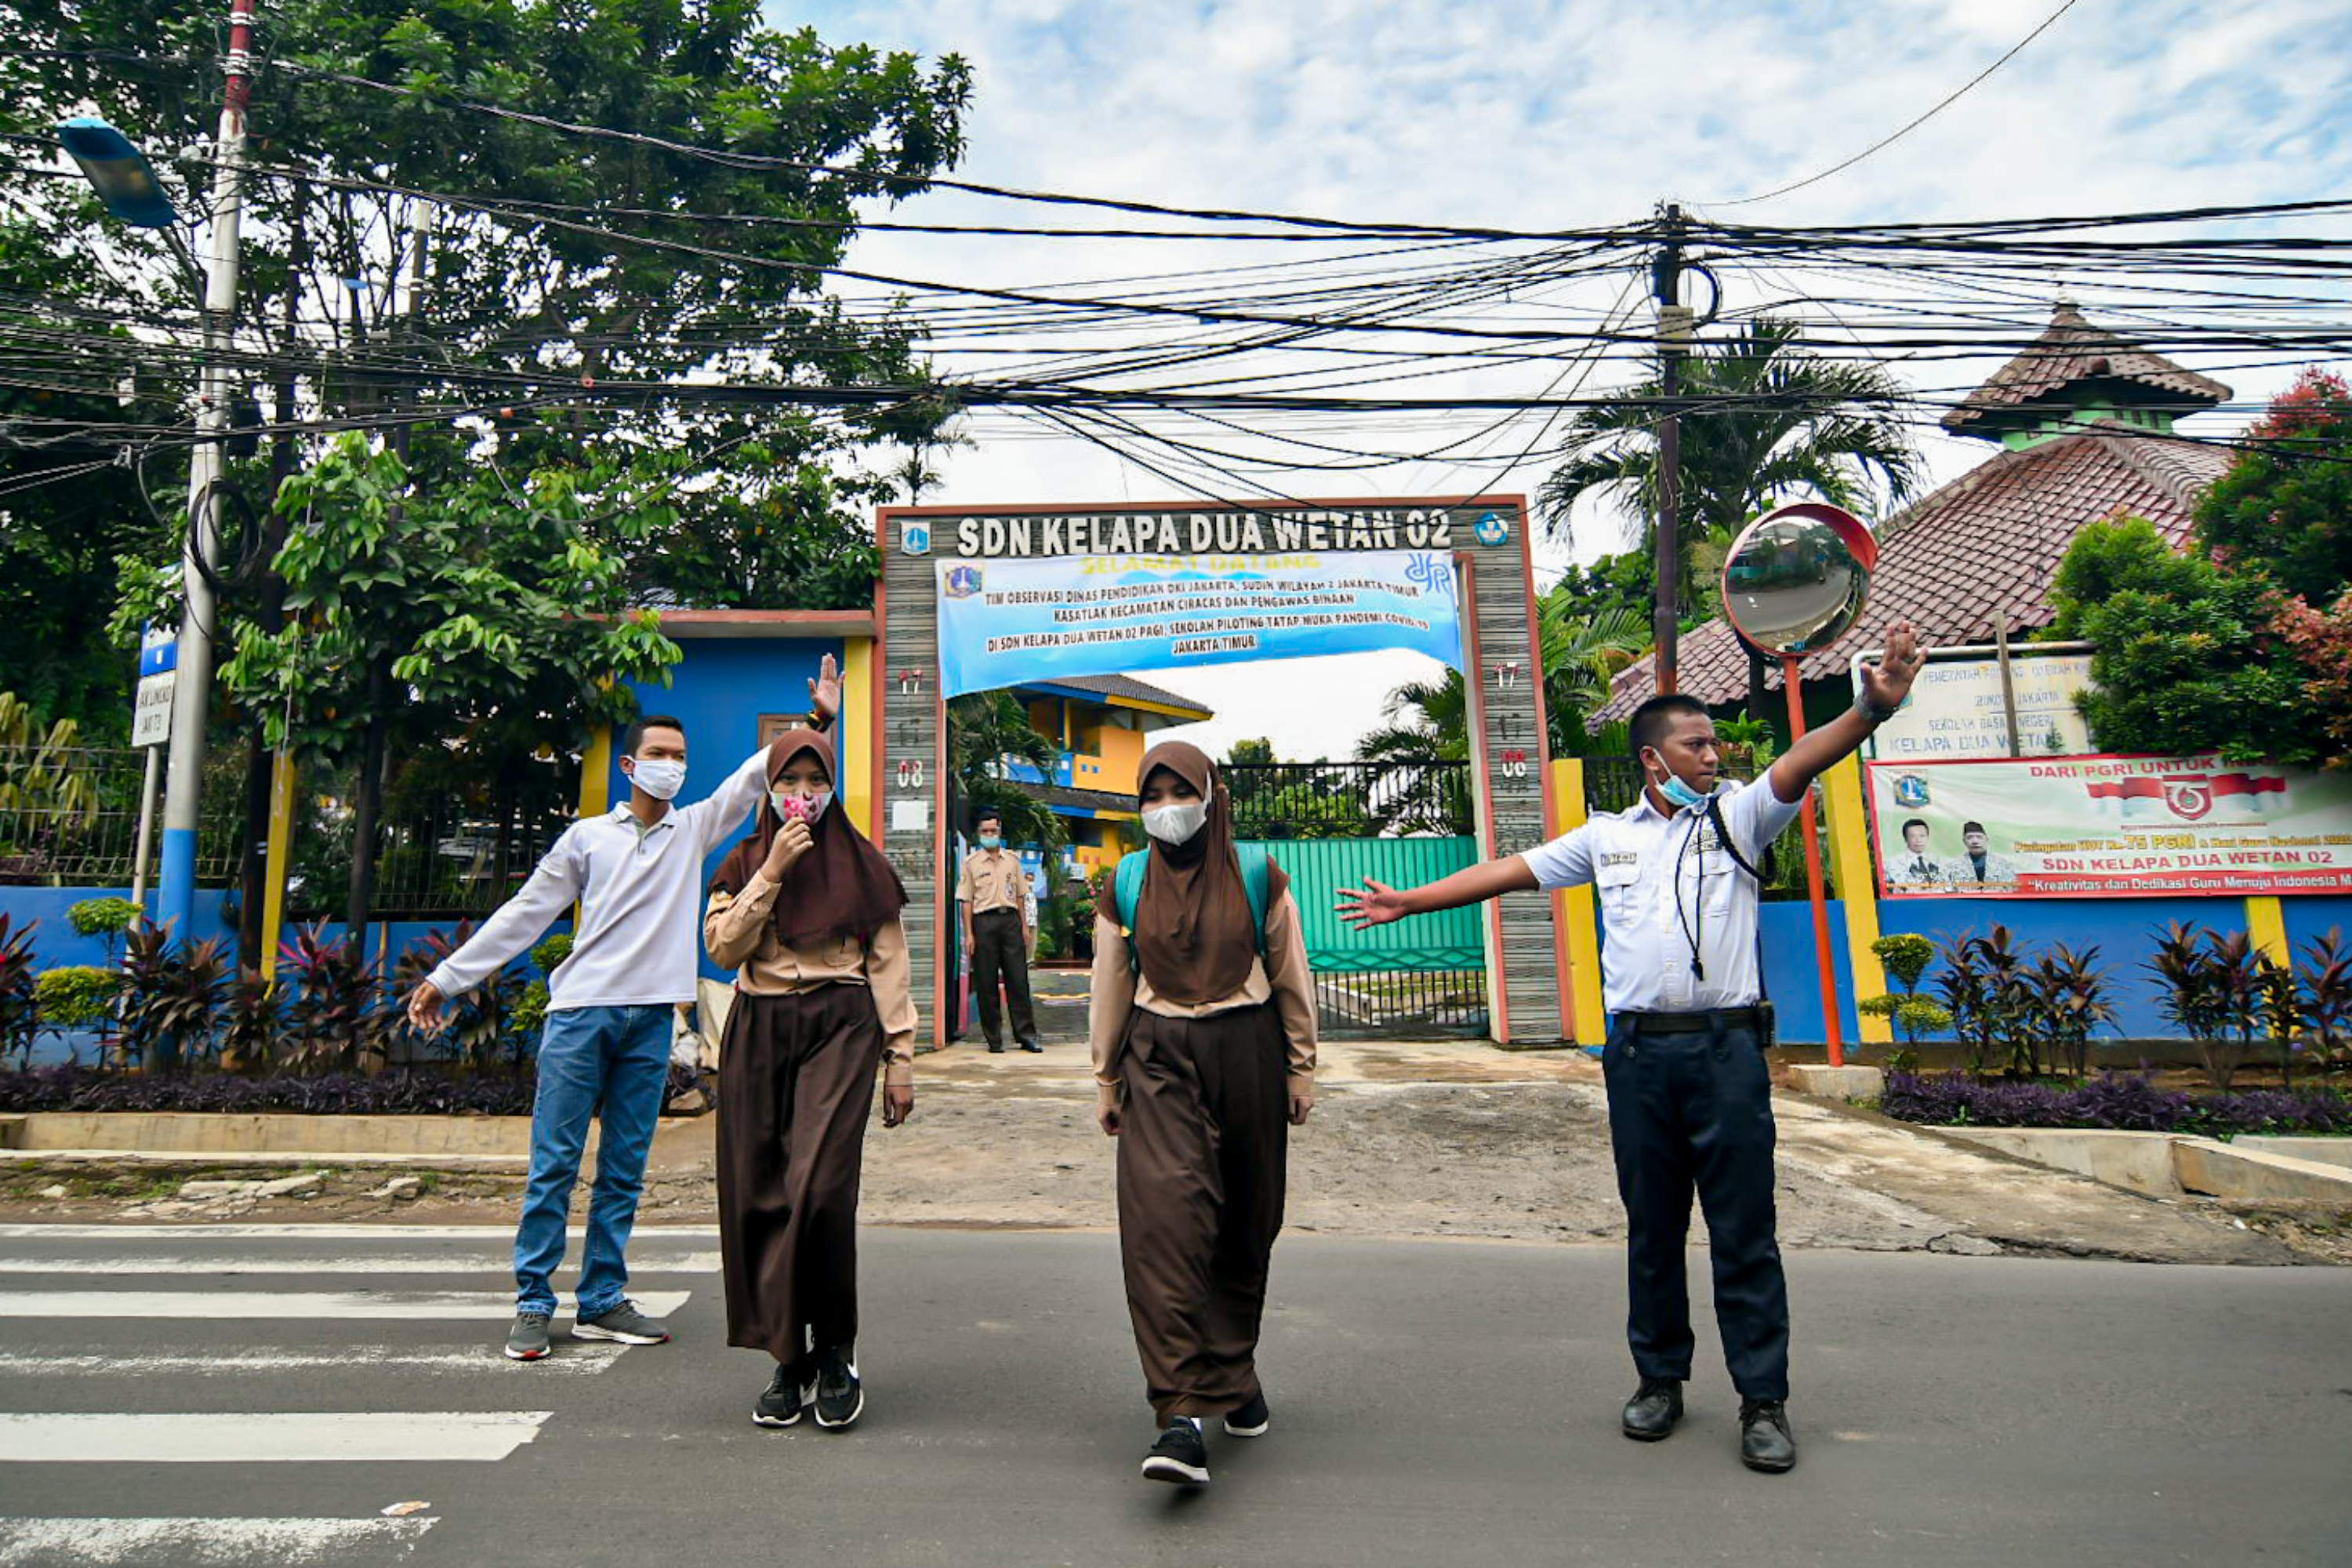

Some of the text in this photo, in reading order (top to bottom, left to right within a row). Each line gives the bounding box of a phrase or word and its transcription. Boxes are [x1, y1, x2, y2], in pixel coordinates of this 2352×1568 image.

[956, 509, 1452, 557] SDN KELAPA DUA WETAN 02
[1081, 556, 1197, 575] SELAMAT
[985, 593, 1004, 606] TIM
[1007, 590, 1063, 604] OBSERVASI
[1066, 590, 1097, 603] DINAS
[1100, 585, 1163, 601] PENDIDIKAN
[1242, 580, 1274, 590] SUDIN
[1338, 579, 1383, 590] JAKARTA
[1386, 583, 1420, 597] TIMUR
[1054, 593, 1355, 622] KASATLAK KECAMATAN CIRACAS DAN PENGAWAS BINAAN
[988, 639, 998, 652] DI
[1001, 636, 1020, 650] SDN
[1023, 633, 1060, 648] KELAPA
[1063, 631, 1084, 645] DUA
[1087, 628, 1123, 643] WETAN
[1169, 619, 1214, 634] SEKOLAH
[1217, 617, 1264, 630] PILOTING
[1266, 615, 1299, 627] TATAP
[1303, 614, 1333, 626] MUKA
[1336, 612, 1382, 624] PANDEMI
[1173, 634, 1256, 654] JAKARTA TIMUR
[898, 670, 923, 695] 17
[898, 760, 923, 788] 08
[2029, 766, 2077, 778] DARI
[2084, 764, 2133, 777] PGRI
[2140, 758, 2216, 774] UNTUK
[2042, 851, 2334, 871] SDN KELAPA DUA WETAN 02
[2106, 879, 2128, 890] dan
[2132, 877, 2186, 890] Dedikasi
[2190, 877, 2221, 889] Guru
[2224, 875, 2271, 892] Menuju
[2274, 873, 2336, 887] Indonesia
